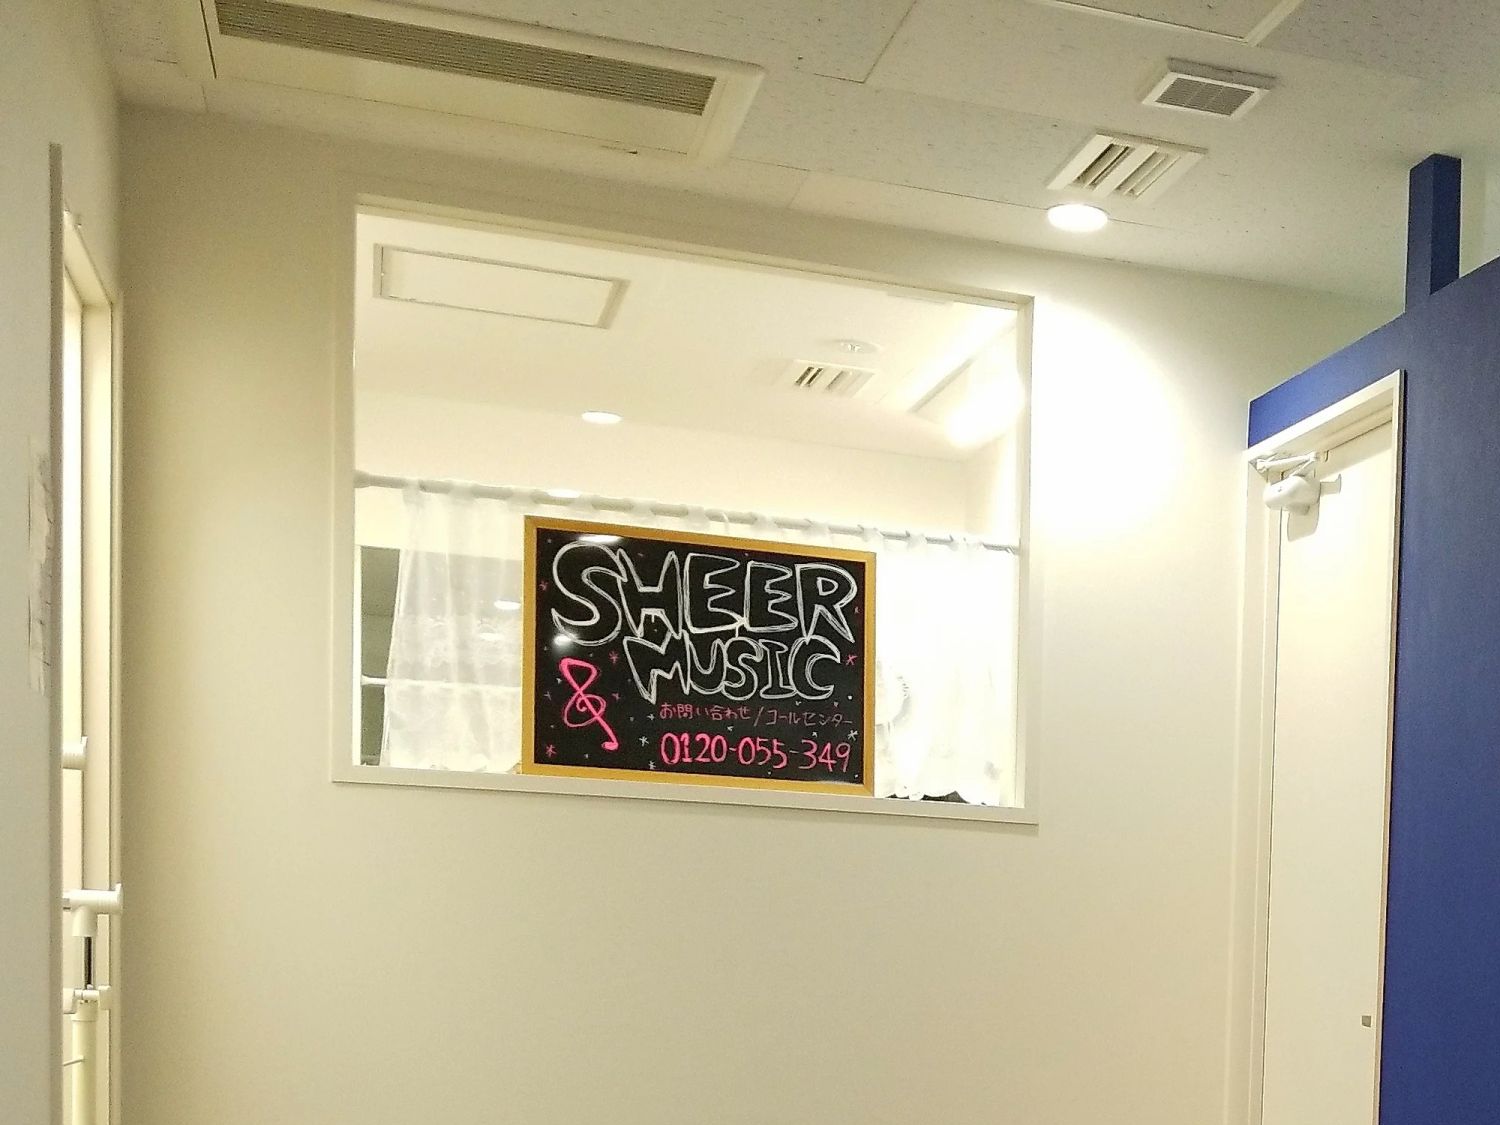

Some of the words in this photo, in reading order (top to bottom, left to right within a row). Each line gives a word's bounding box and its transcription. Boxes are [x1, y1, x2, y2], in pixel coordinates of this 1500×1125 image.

[551, 540, 858, 647] SHEER
[623, 630, 841, 705] MUSIC
[660, 732, 852, 773] 0120-055-349
